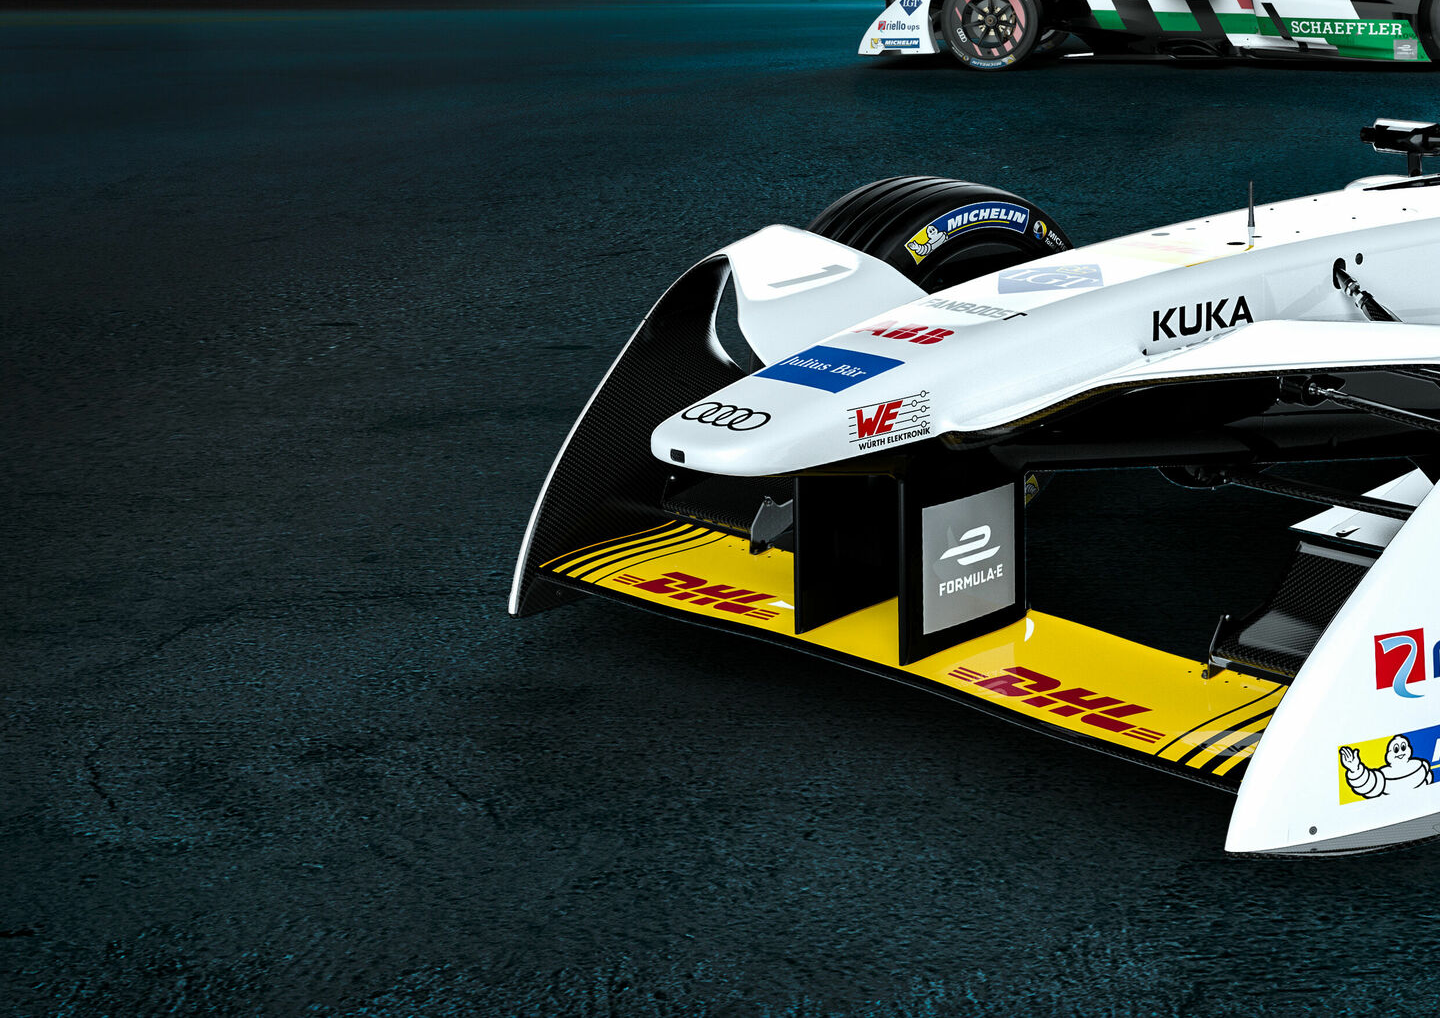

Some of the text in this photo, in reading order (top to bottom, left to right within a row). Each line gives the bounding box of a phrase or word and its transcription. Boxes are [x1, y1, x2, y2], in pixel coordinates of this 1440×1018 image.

[886, 20, 906, 31] riello
[1290, 20, 1403, 36] SCHAEFFLER
[947, 207, 1027, 232] MICHELIN
[1000, 269, 1100, 288] LGT
[921, 298, 1028, 321] FANBOOST
[1152, 295, 1254, 342] KUKA
[852, 320, 955, 345] ABB
[778, 355, 867, 379] Julius Bär
[855, 399, 904, 439] WE
[859, 426, 931, 451] WÜRTH ELEKTRONIK
[631, 571, 778, 616] DHL
[971, 666, 1153, 735] DHL
